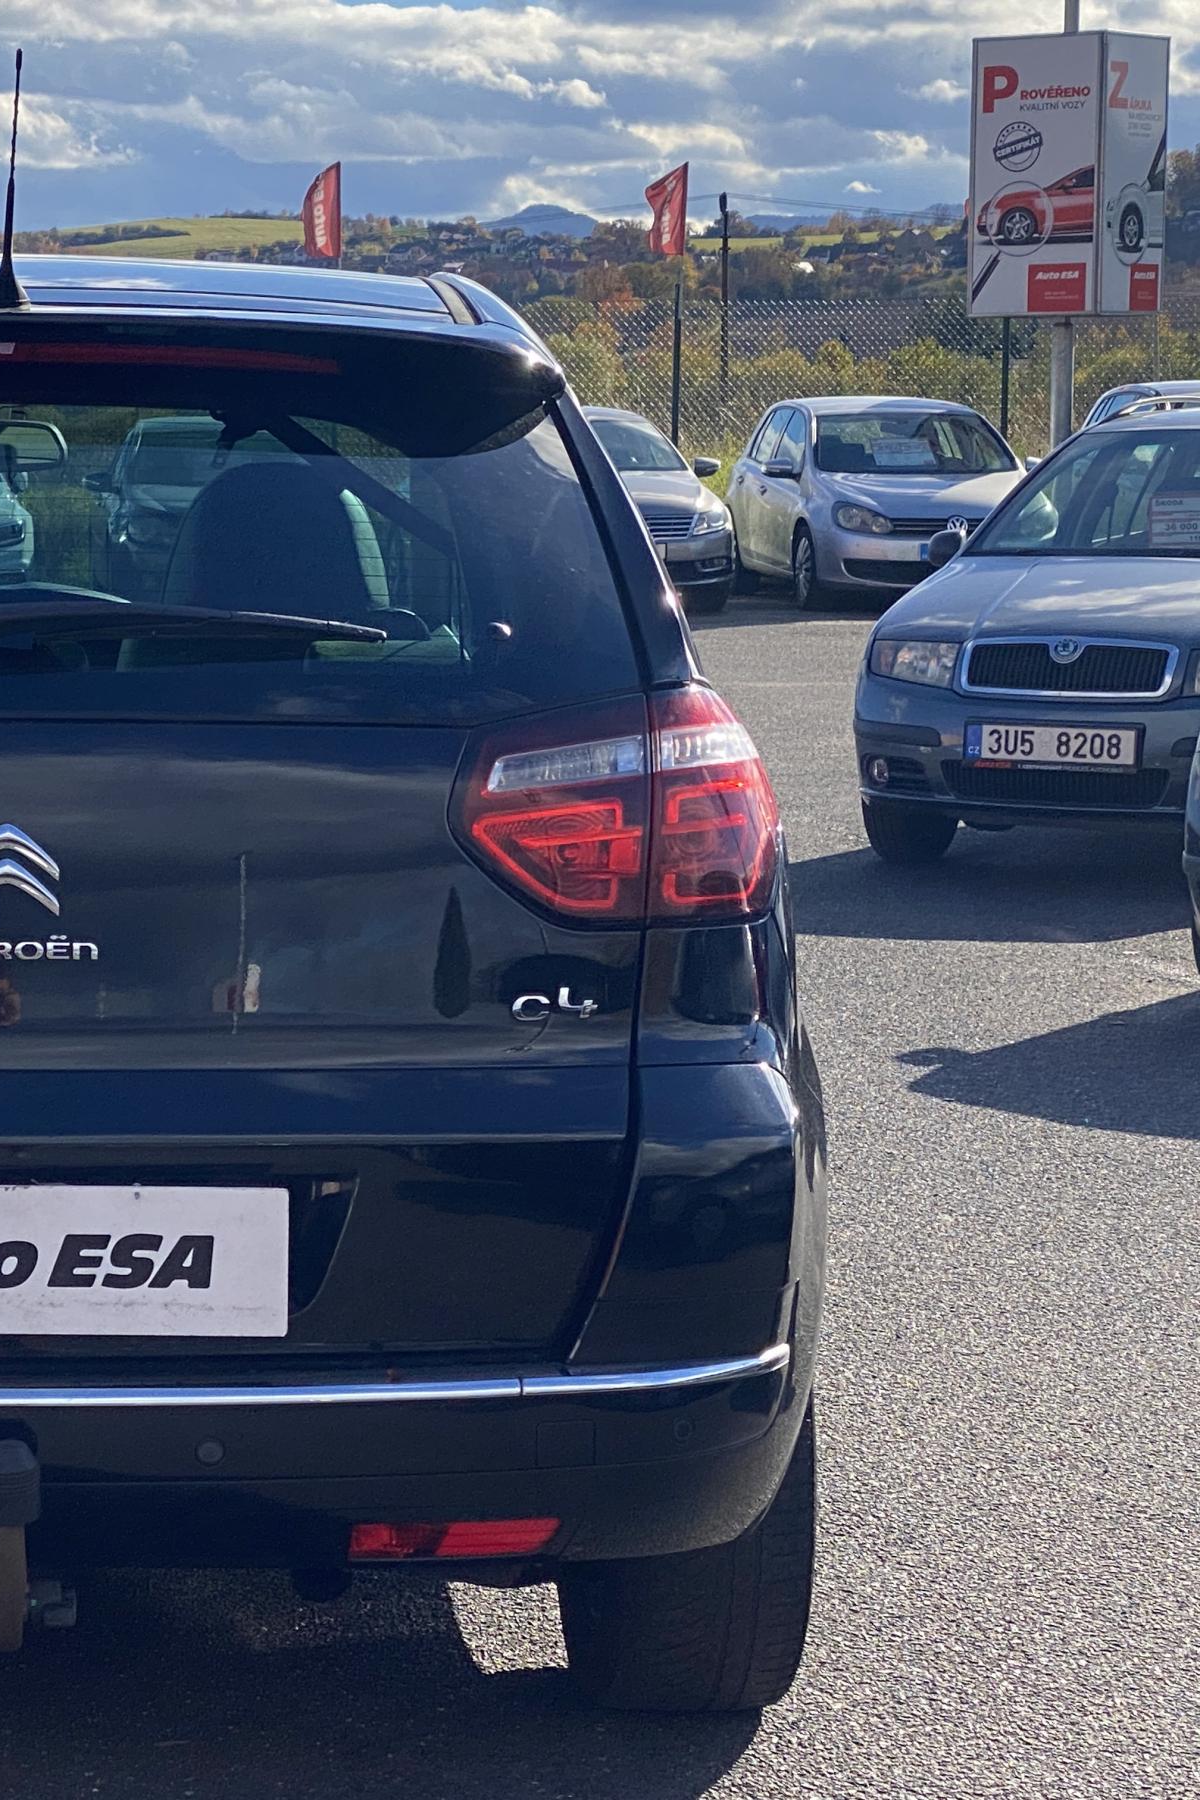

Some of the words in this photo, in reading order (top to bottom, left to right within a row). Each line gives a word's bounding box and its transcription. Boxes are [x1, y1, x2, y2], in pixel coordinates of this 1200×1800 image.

[1061, 101, 1086, 110] VOZY
[1035, 272, 1059, 280] Auto
[1061, 271, 1079, 279] ESA
[968, 745, 980, 754] CZ
[988, 729, 1034, 756] 3U5
[1056, 731, 1121, 760] 8208
[512, 987, 598, 1021] C4
[47, 1233, 215, 1289] ESA
